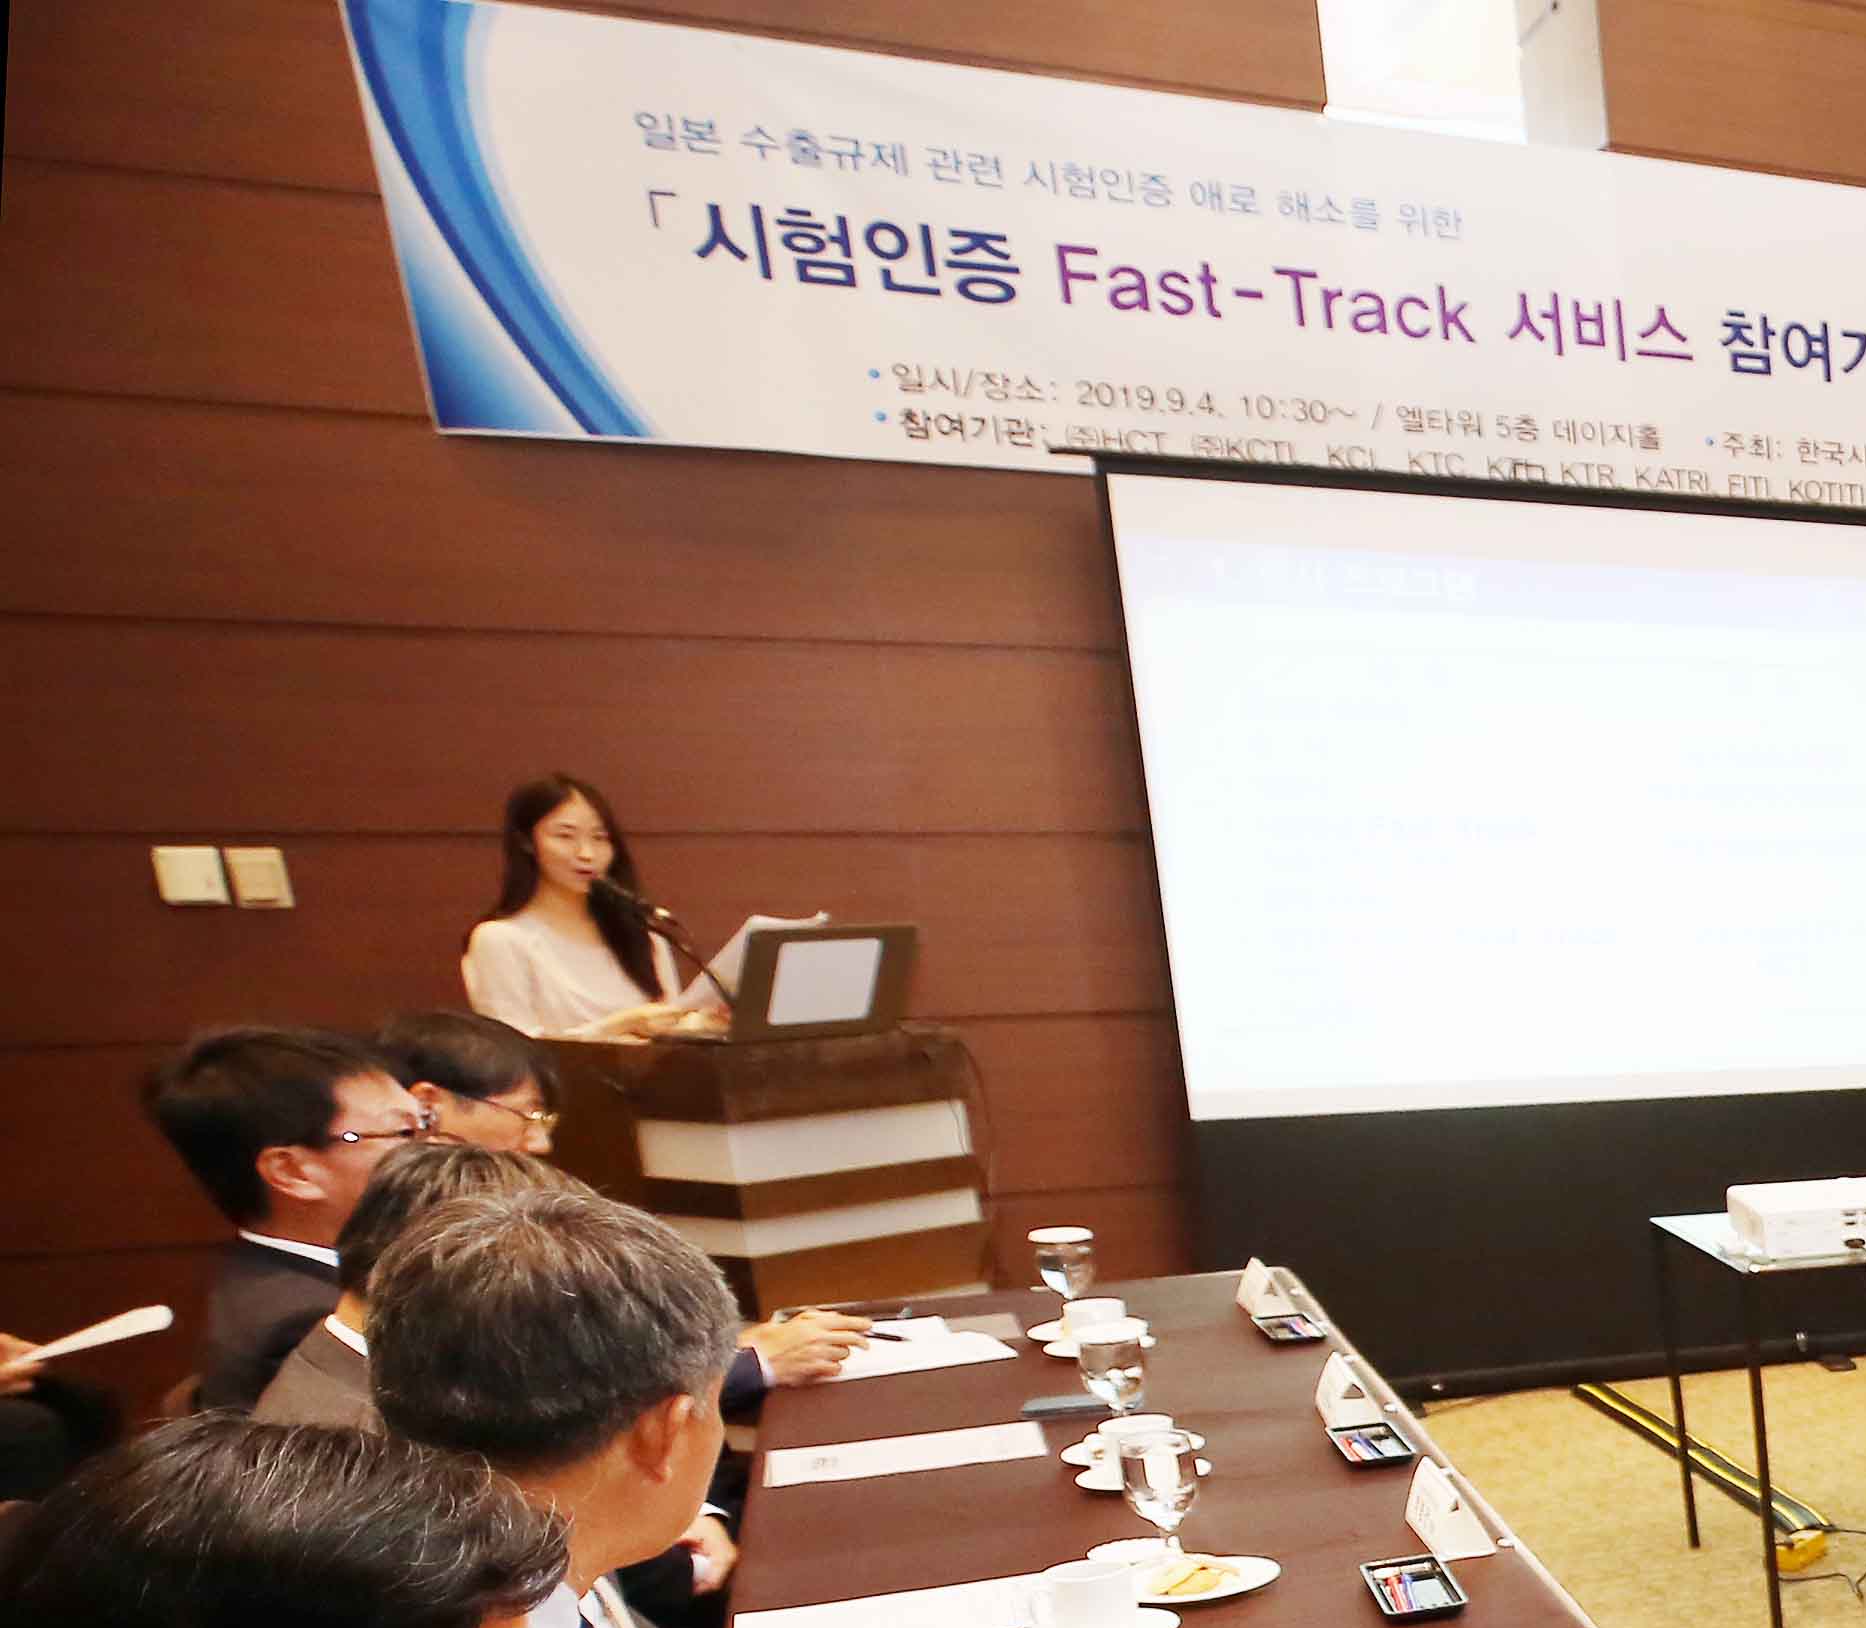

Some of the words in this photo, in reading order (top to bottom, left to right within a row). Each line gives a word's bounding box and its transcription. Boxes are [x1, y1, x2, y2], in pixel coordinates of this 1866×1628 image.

[634, 111, 721, 155] 일본
[740, 124, 909, 176] 수출규제
[924, 146, 1003, 188] 관련
[1023, 160, 1174, 208] 시험인증
[1189, 179, 1262, 216] 애로
[1276, 190, 1380, 232] 해소를
[1395, 202, 1463, 240] 위한
[1055, 242, 1476, 344] Fast-Track
[1506, 290, 1694, 366] 서비스
[892, 362, 1057, 403] 일시/장소:
[1074, 380, 1225, 419] 2019.9.4.
[1395, 404, 1485, 439] 엘타워
[1495, 413, 1540, 443] 5층
[1553, 416, 1661, 451] 데이지홀
[1722, 431, 1784, 461] 주최:
